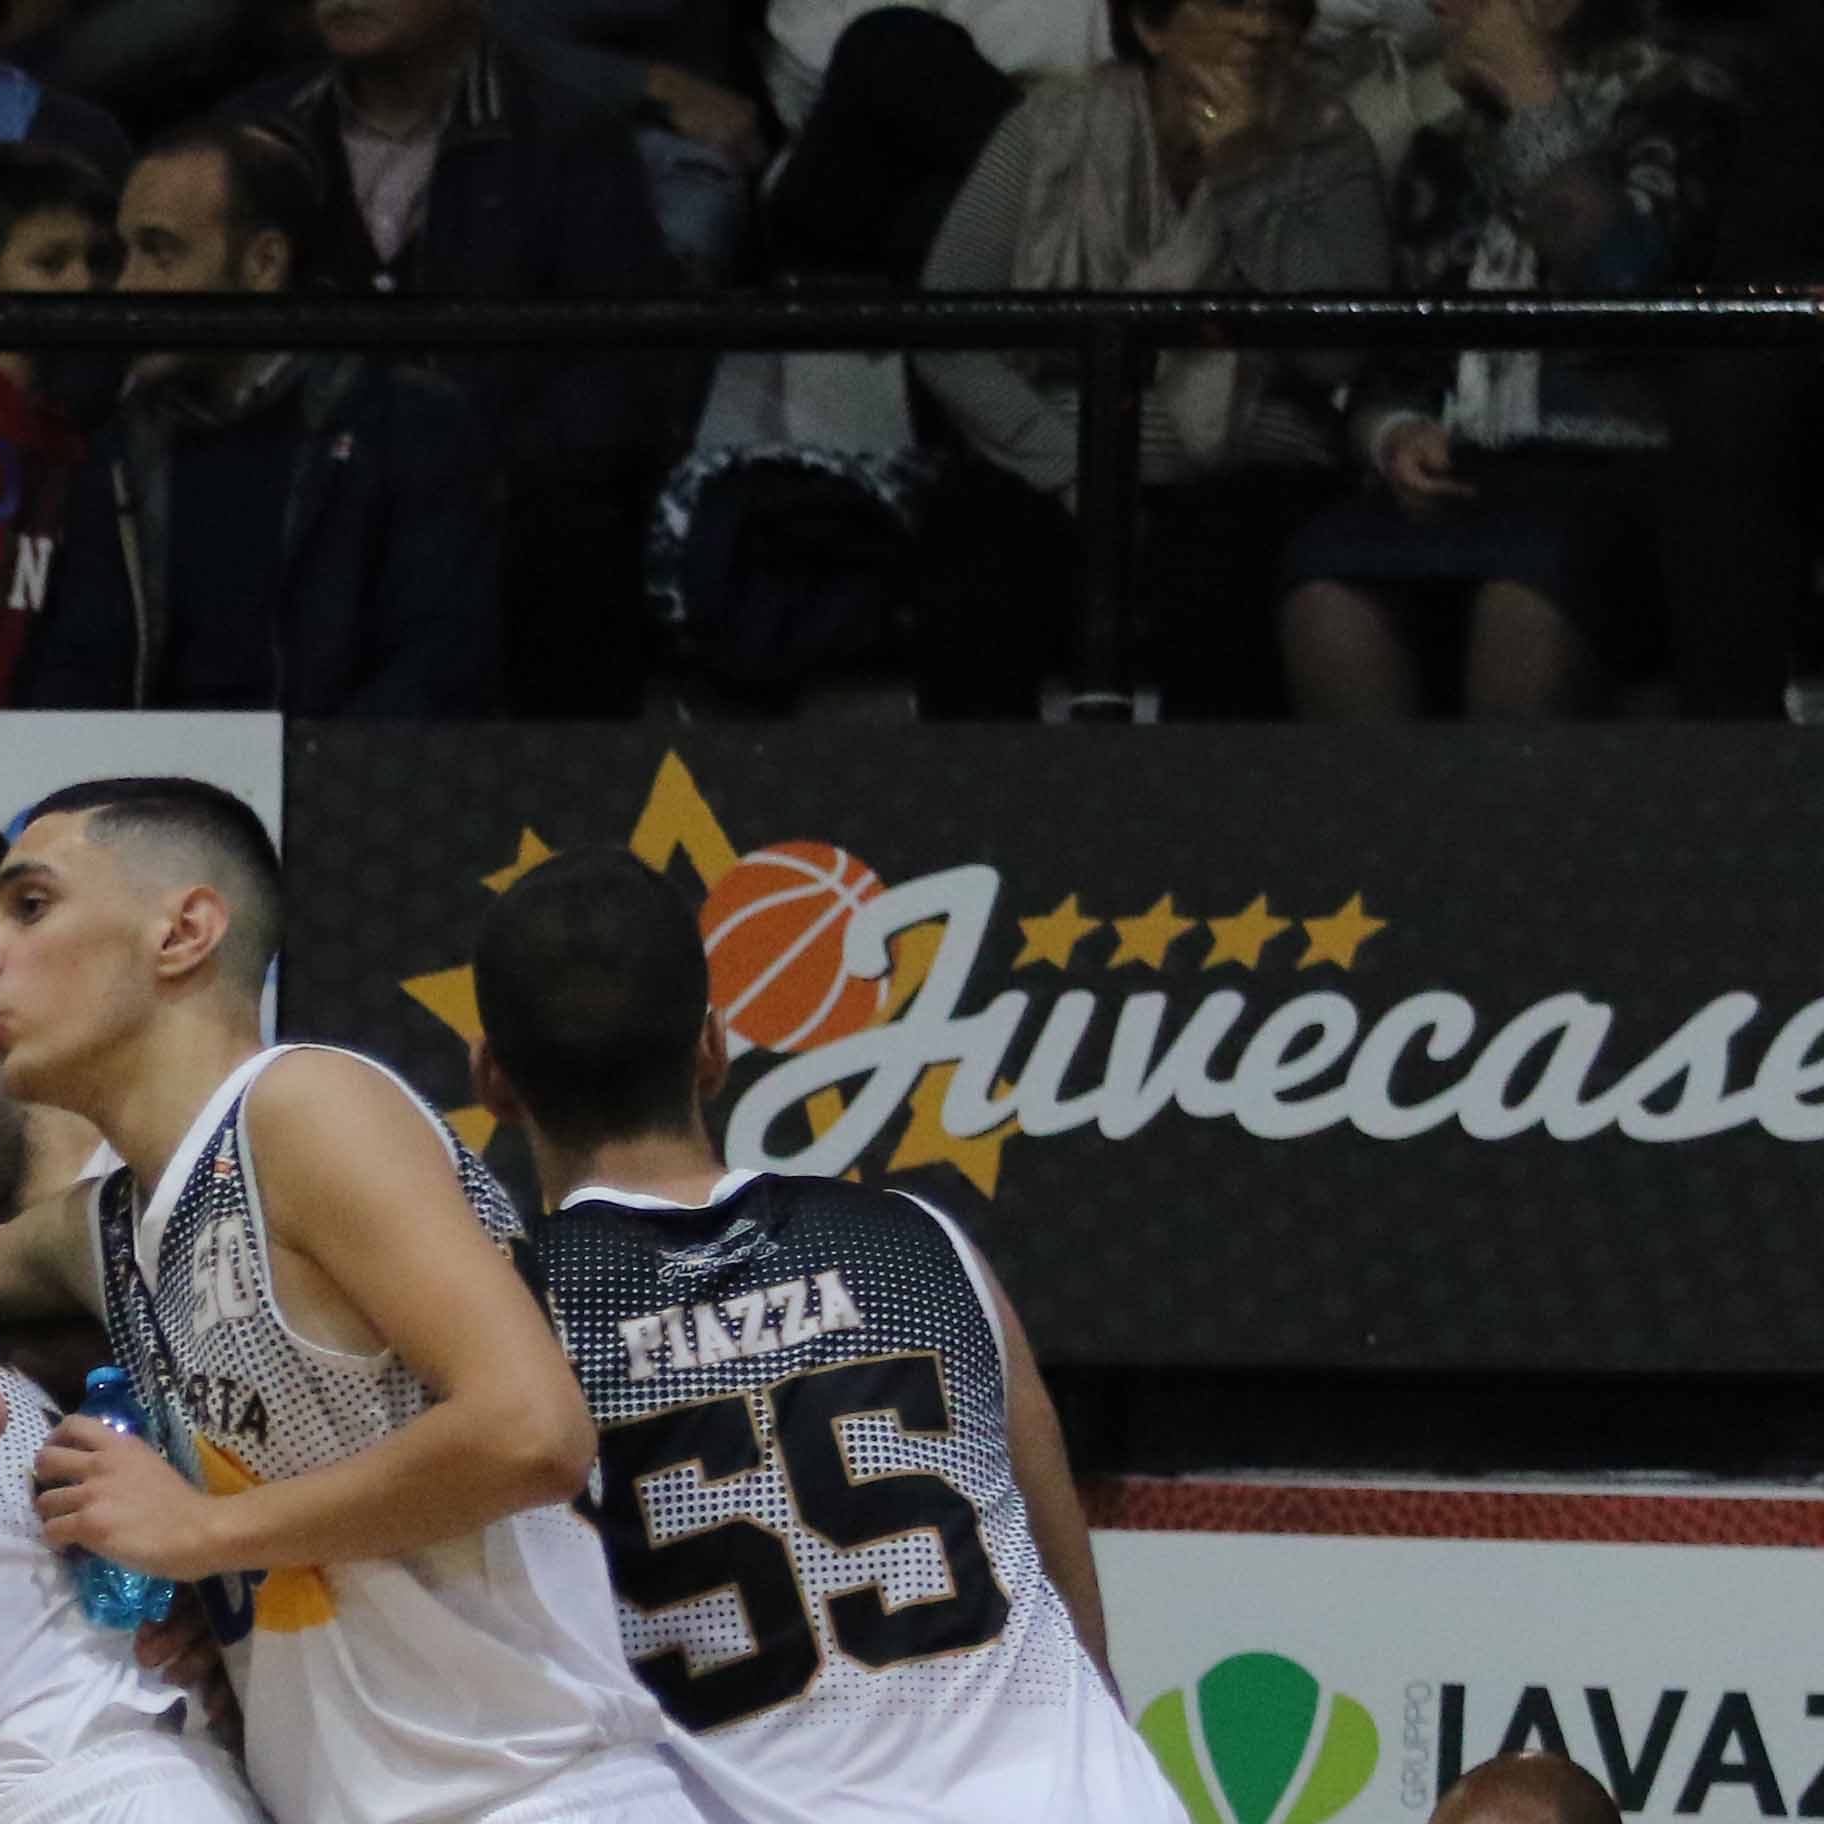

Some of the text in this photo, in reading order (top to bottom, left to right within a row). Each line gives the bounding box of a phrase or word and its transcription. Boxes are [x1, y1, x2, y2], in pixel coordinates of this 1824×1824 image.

[618, 1269, 864, 1381] PIAZZA
[584, 1348, 1012, 1734] 55
[1400, 1678, 1432, 1810] GRUPPO
[1437, 1683, 1824, 1818] IAVA
